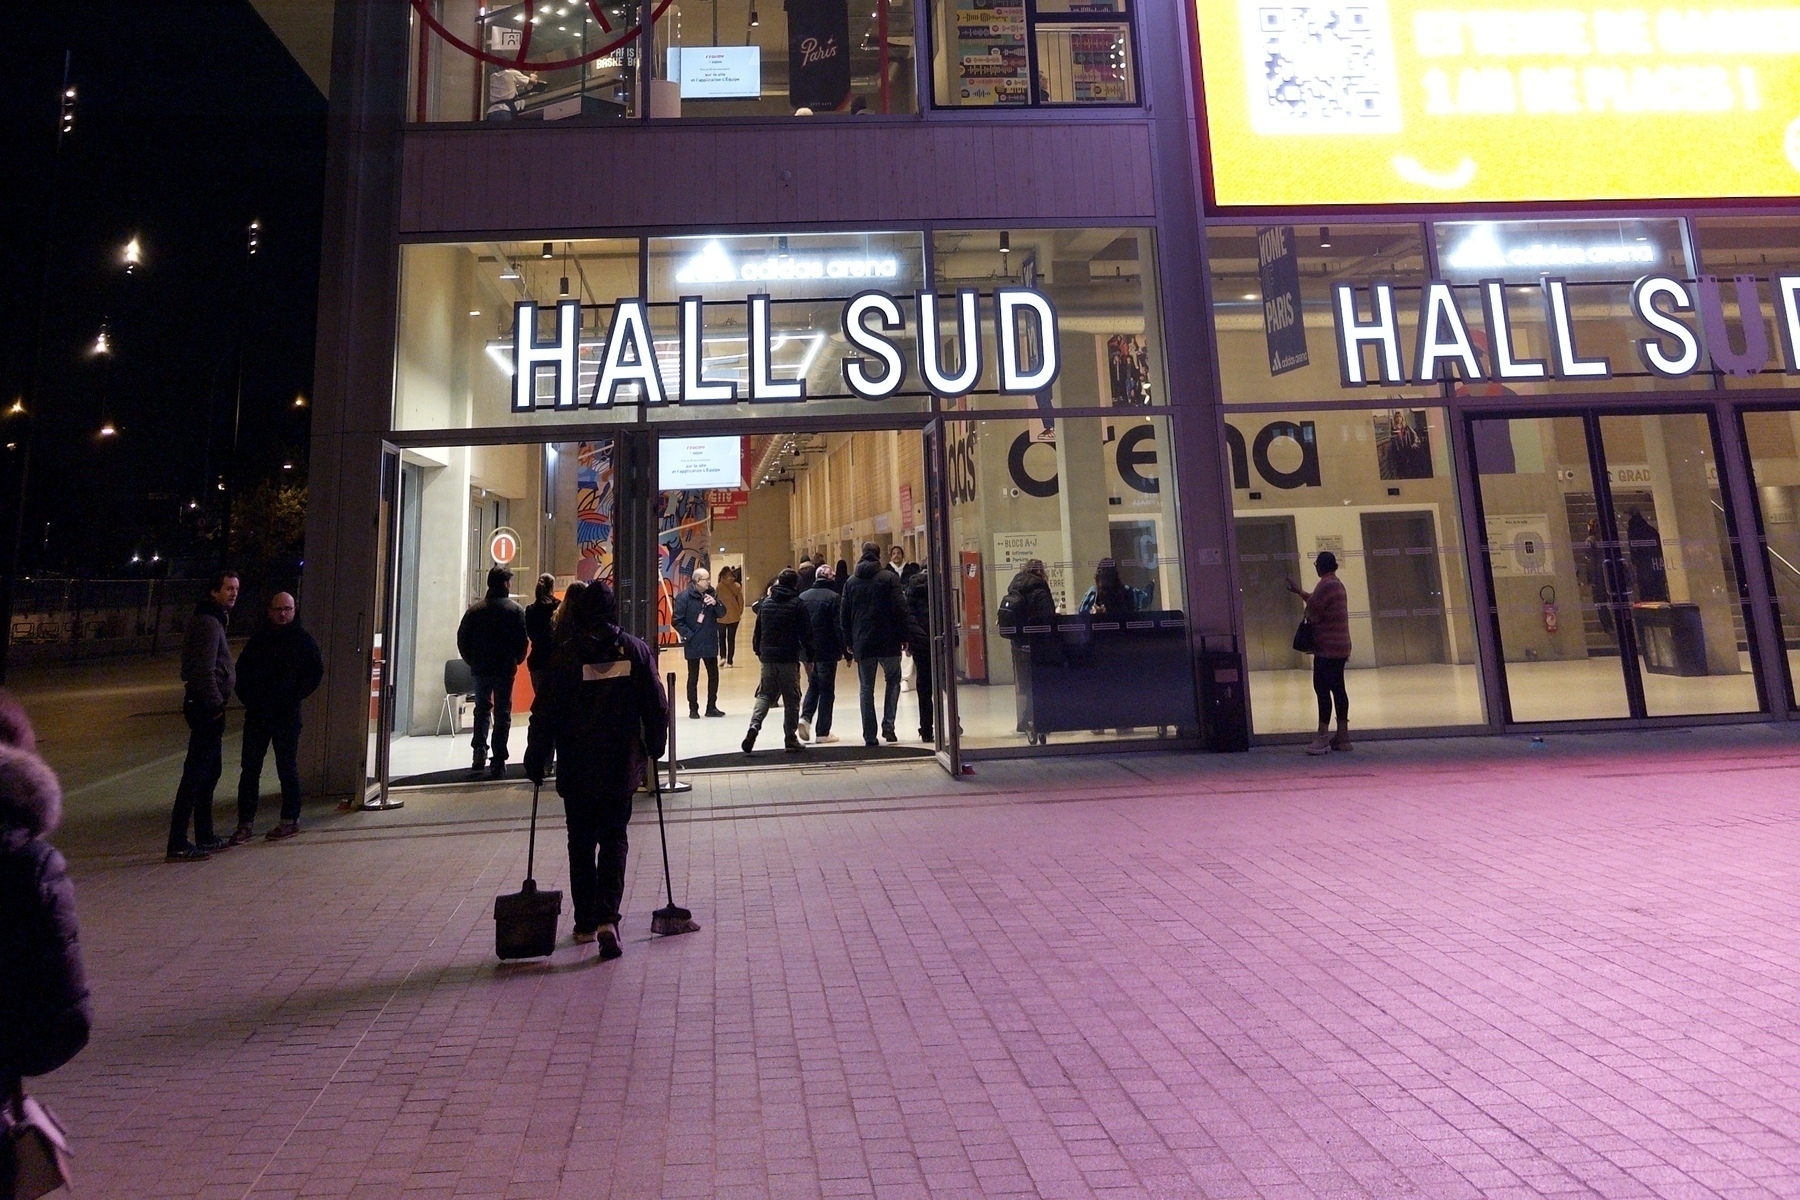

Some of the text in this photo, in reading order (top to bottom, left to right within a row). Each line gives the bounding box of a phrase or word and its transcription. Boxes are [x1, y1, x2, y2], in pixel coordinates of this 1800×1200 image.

[800, 34, 838, 67] Paris
[1258, 227, 1288, 267] HOME
[741, 259, 898, 281] adidas arena
[1265, 292, 1295, 334] PARIS
[1330, 276, 1612, 388] HALL
[511, 287, 1060, 413] HALL SUD
[1004, 539, 1024, 548] BLOCS
